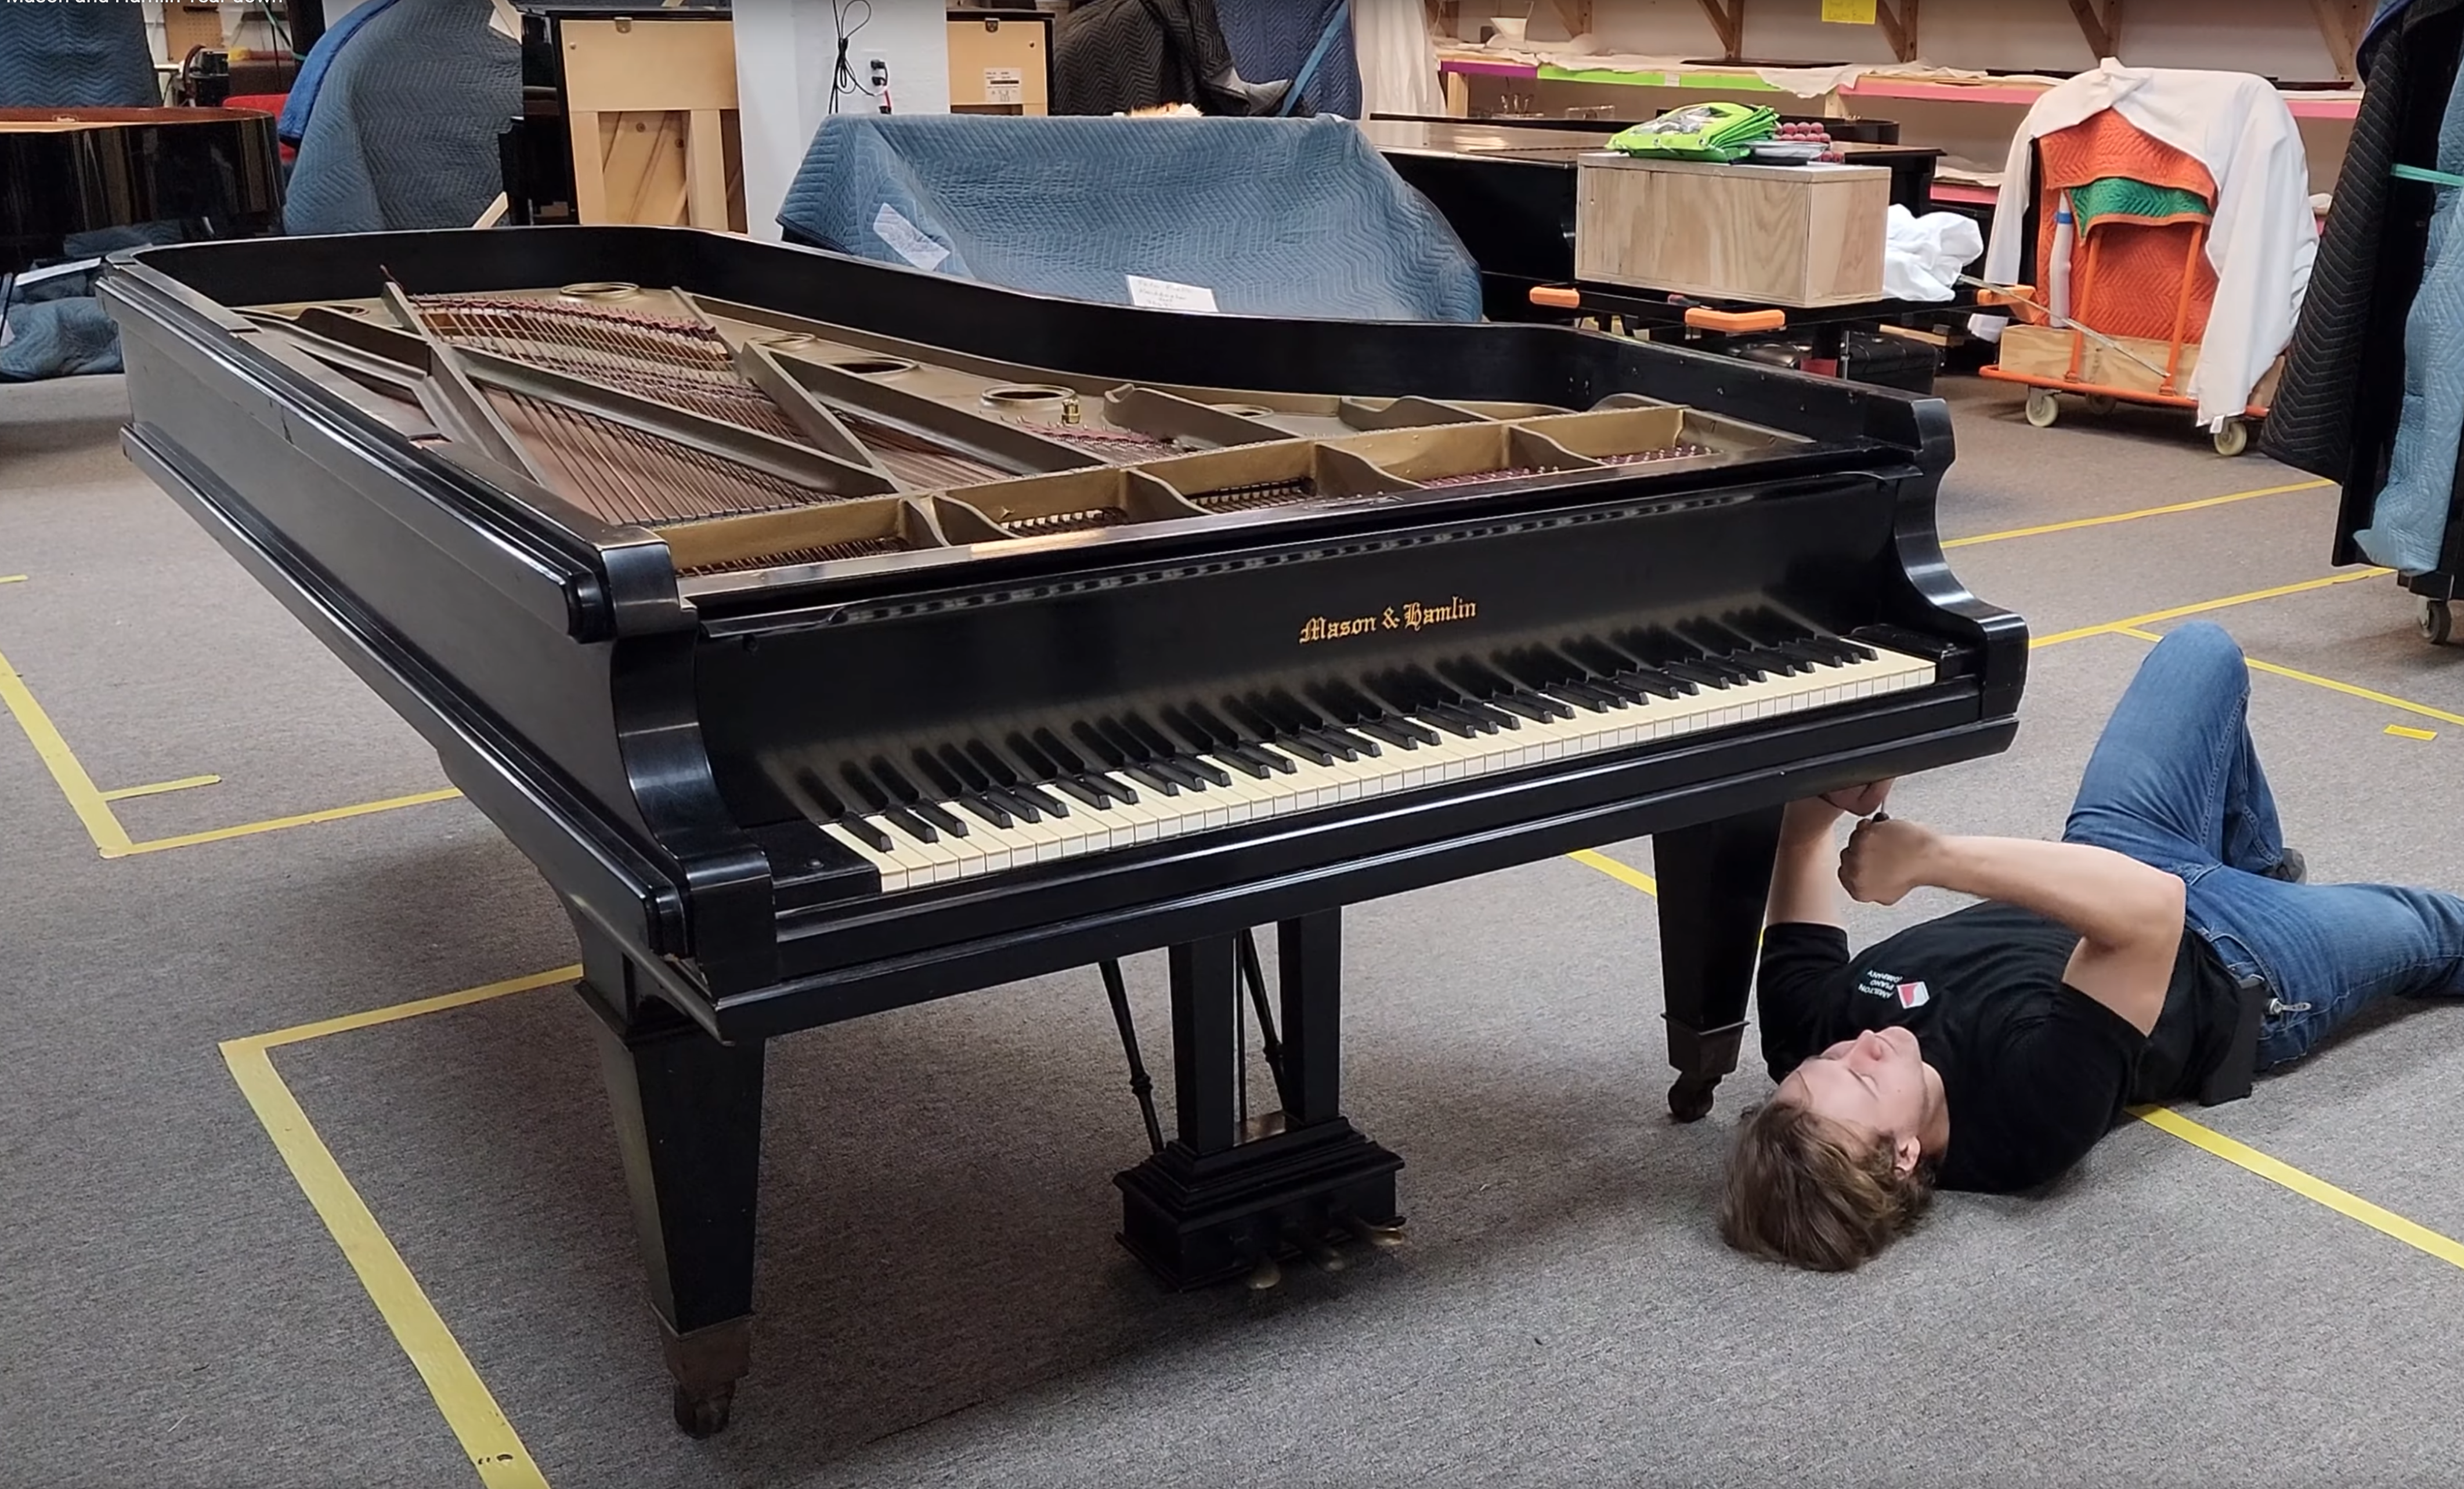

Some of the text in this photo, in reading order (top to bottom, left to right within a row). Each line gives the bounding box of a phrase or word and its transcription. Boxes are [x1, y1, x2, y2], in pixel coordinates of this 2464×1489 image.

[1299, 596, 1477, 644] Mason & Hamlin
[1858, 983, 1894, 999] AMILTON
[1870, 980, 1895, 991] PIANO
